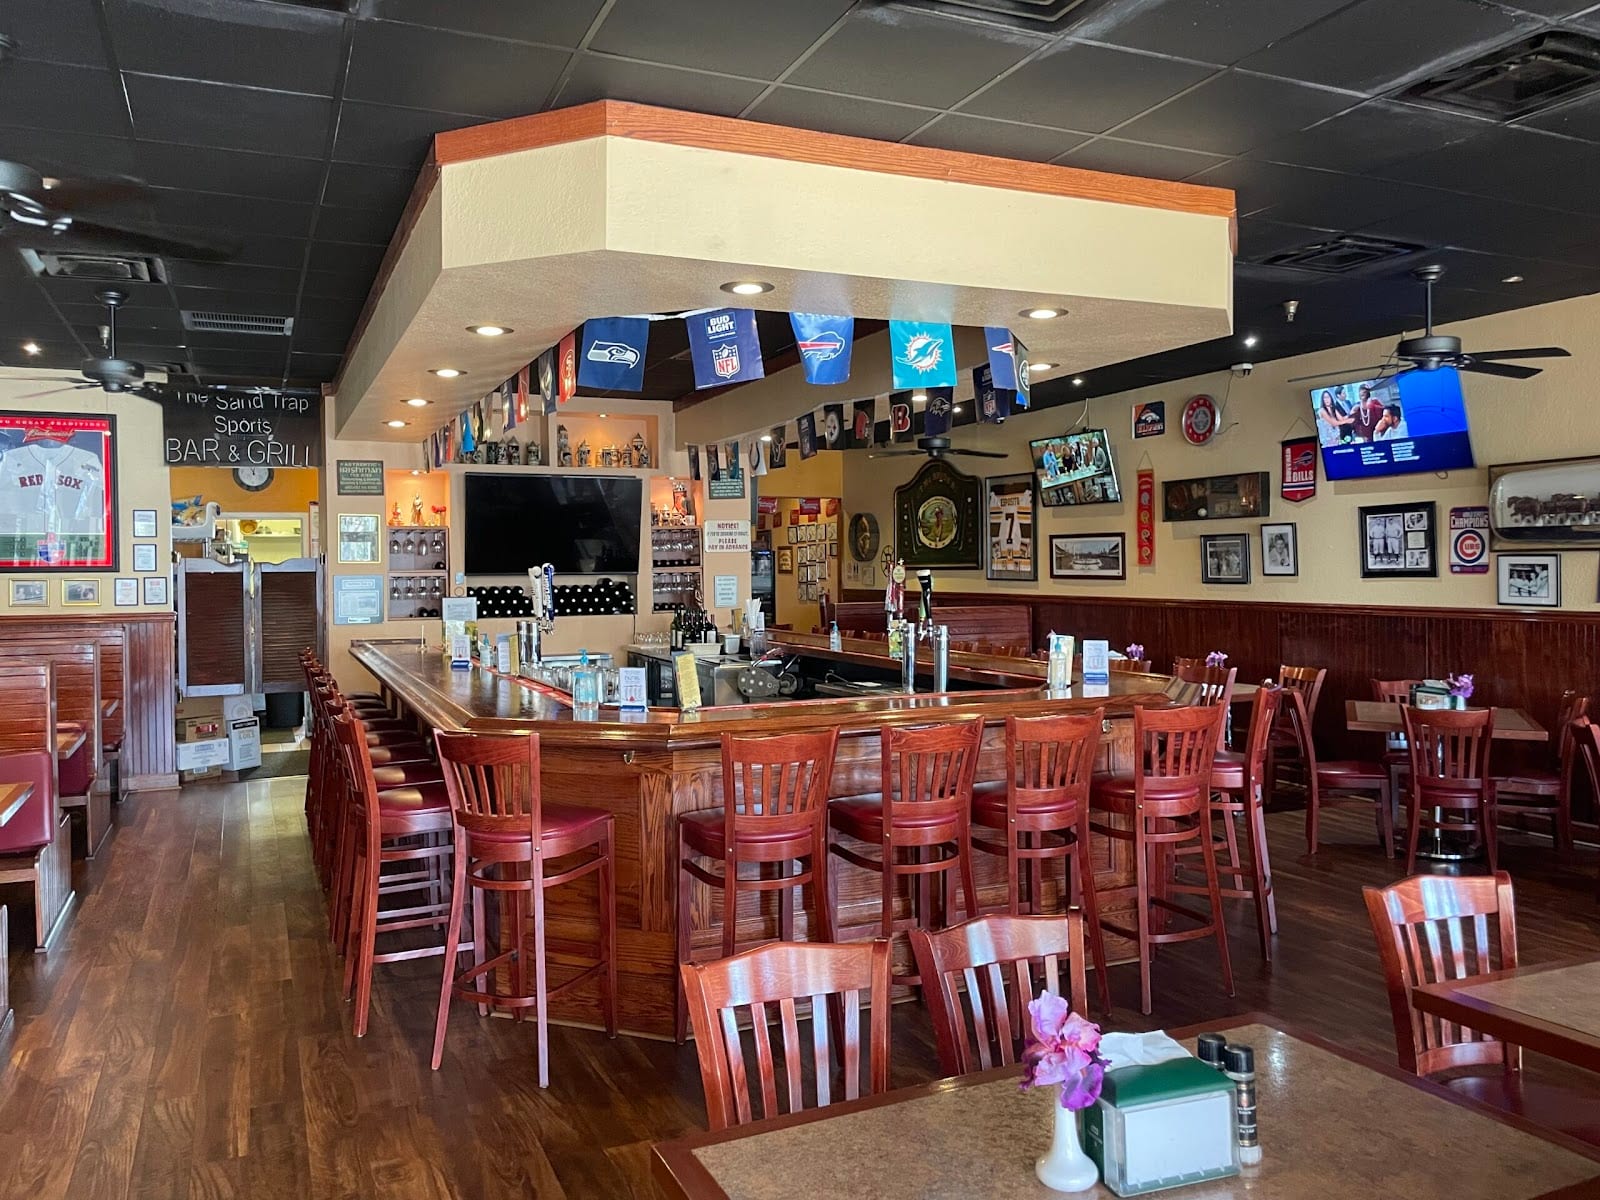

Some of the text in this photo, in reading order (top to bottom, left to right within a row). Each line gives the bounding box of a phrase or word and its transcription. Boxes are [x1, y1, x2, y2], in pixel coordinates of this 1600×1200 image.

[707, 320, 735, 334] LIGHT
[709, 314, 730, 326] BUD
[717, 357, 738, 373] NFL
[273, 394, 309, 413] Trap
[214, 415, 272, 435] Sports
[166, 438, 221, 463] BAR
[228, 444, 241, 462] &
[18, 473, 84, 490] RED SOX
[1292, 470, 1314, 482] BILLS
[1005, 512, 1015, 545] 7
[1451, 515, 1489, 528] CHAMPIONS
